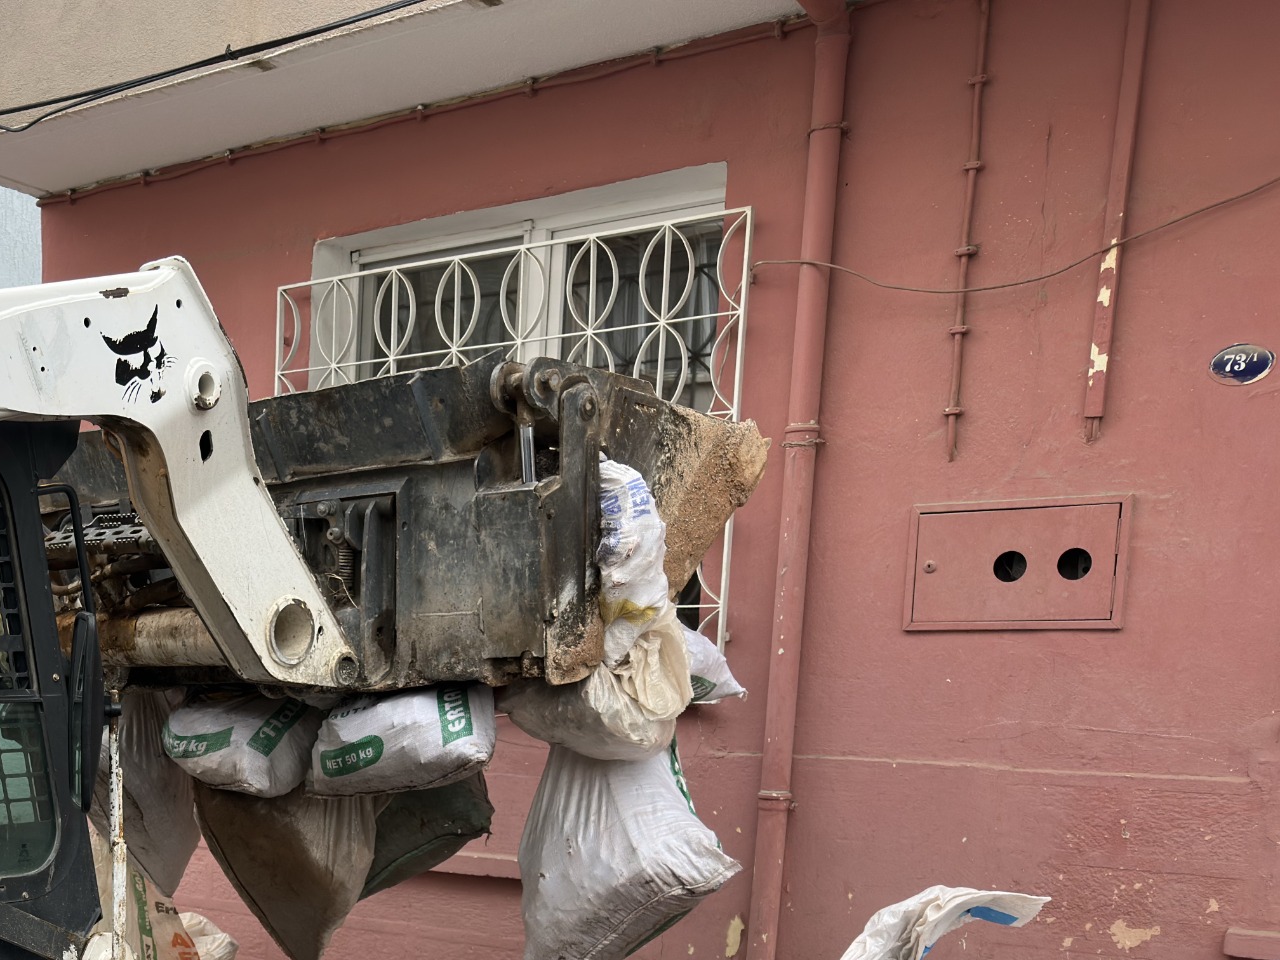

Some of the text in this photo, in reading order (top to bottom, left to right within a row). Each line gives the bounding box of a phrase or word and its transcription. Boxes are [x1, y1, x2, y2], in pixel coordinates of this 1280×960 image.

[1223, 352, 1259, 373] 73/1
[446, 686, 468, 733] ERTA
[188, 739, 208, 755] kg
[325, 746, 374, 771] NET 50 kg
